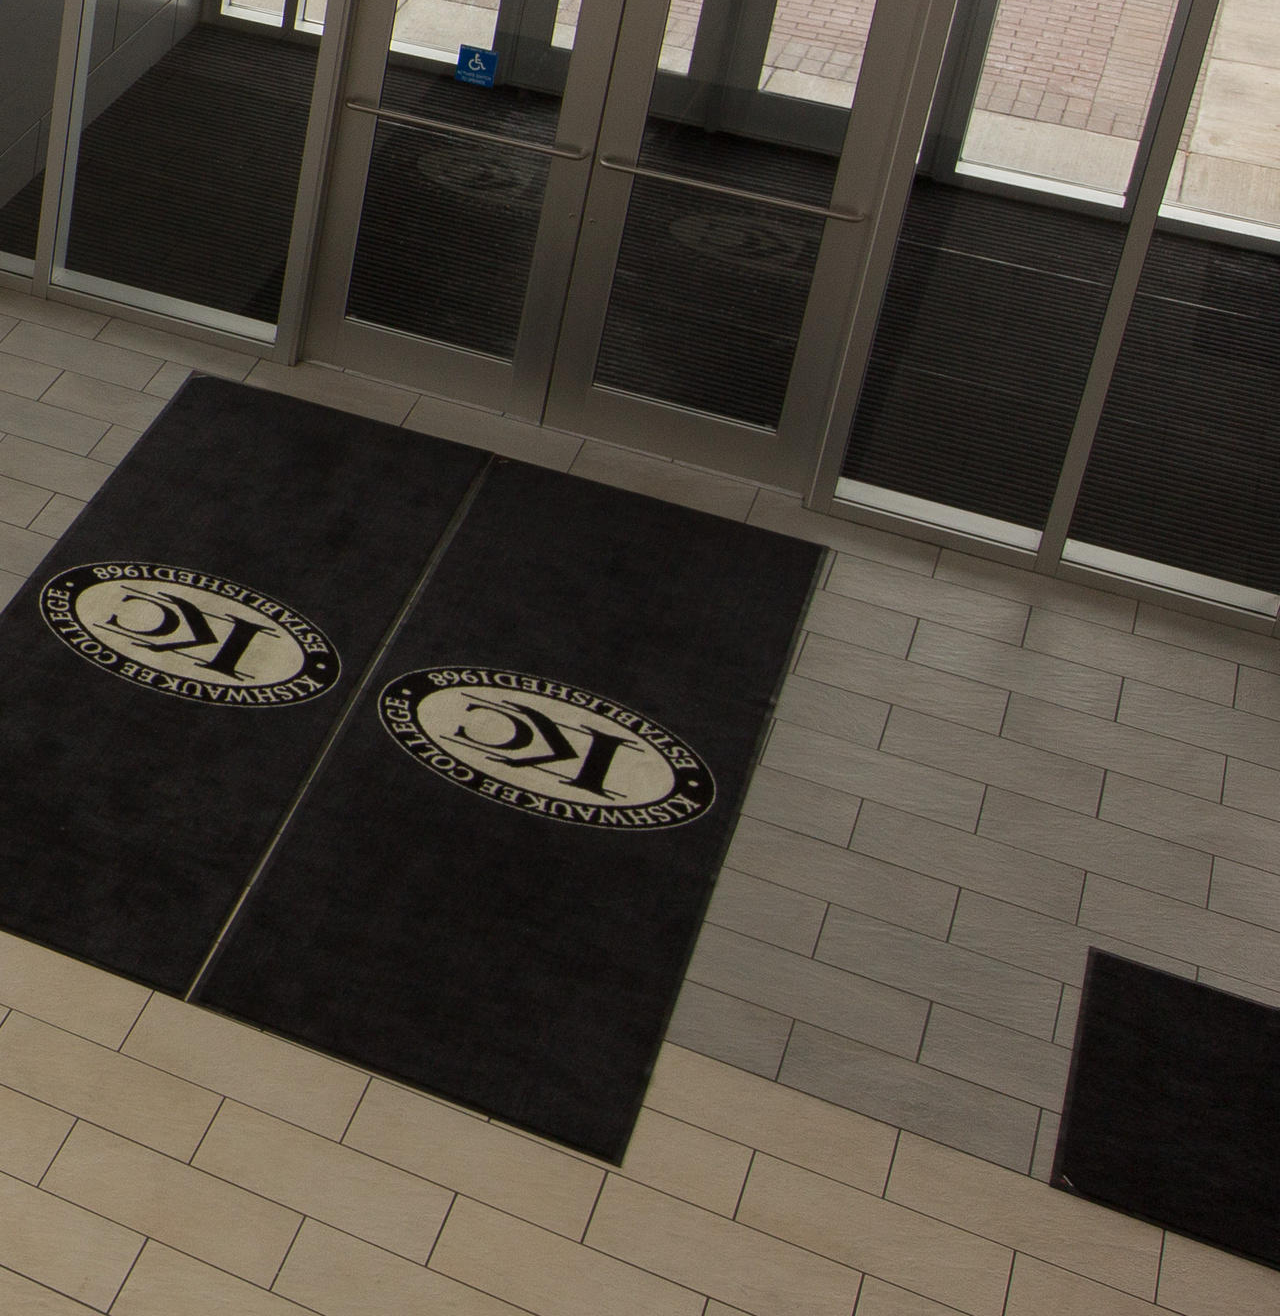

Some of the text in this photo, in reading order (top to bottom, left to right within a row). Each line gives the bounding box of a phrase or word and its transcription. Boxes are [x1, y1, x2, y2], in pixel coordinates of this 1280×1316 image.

[47, 588, 326, 705] KISHWAUKEE COLLEGE
[385, 696, 704, 826] KISHWAUKEE COLLEGE
